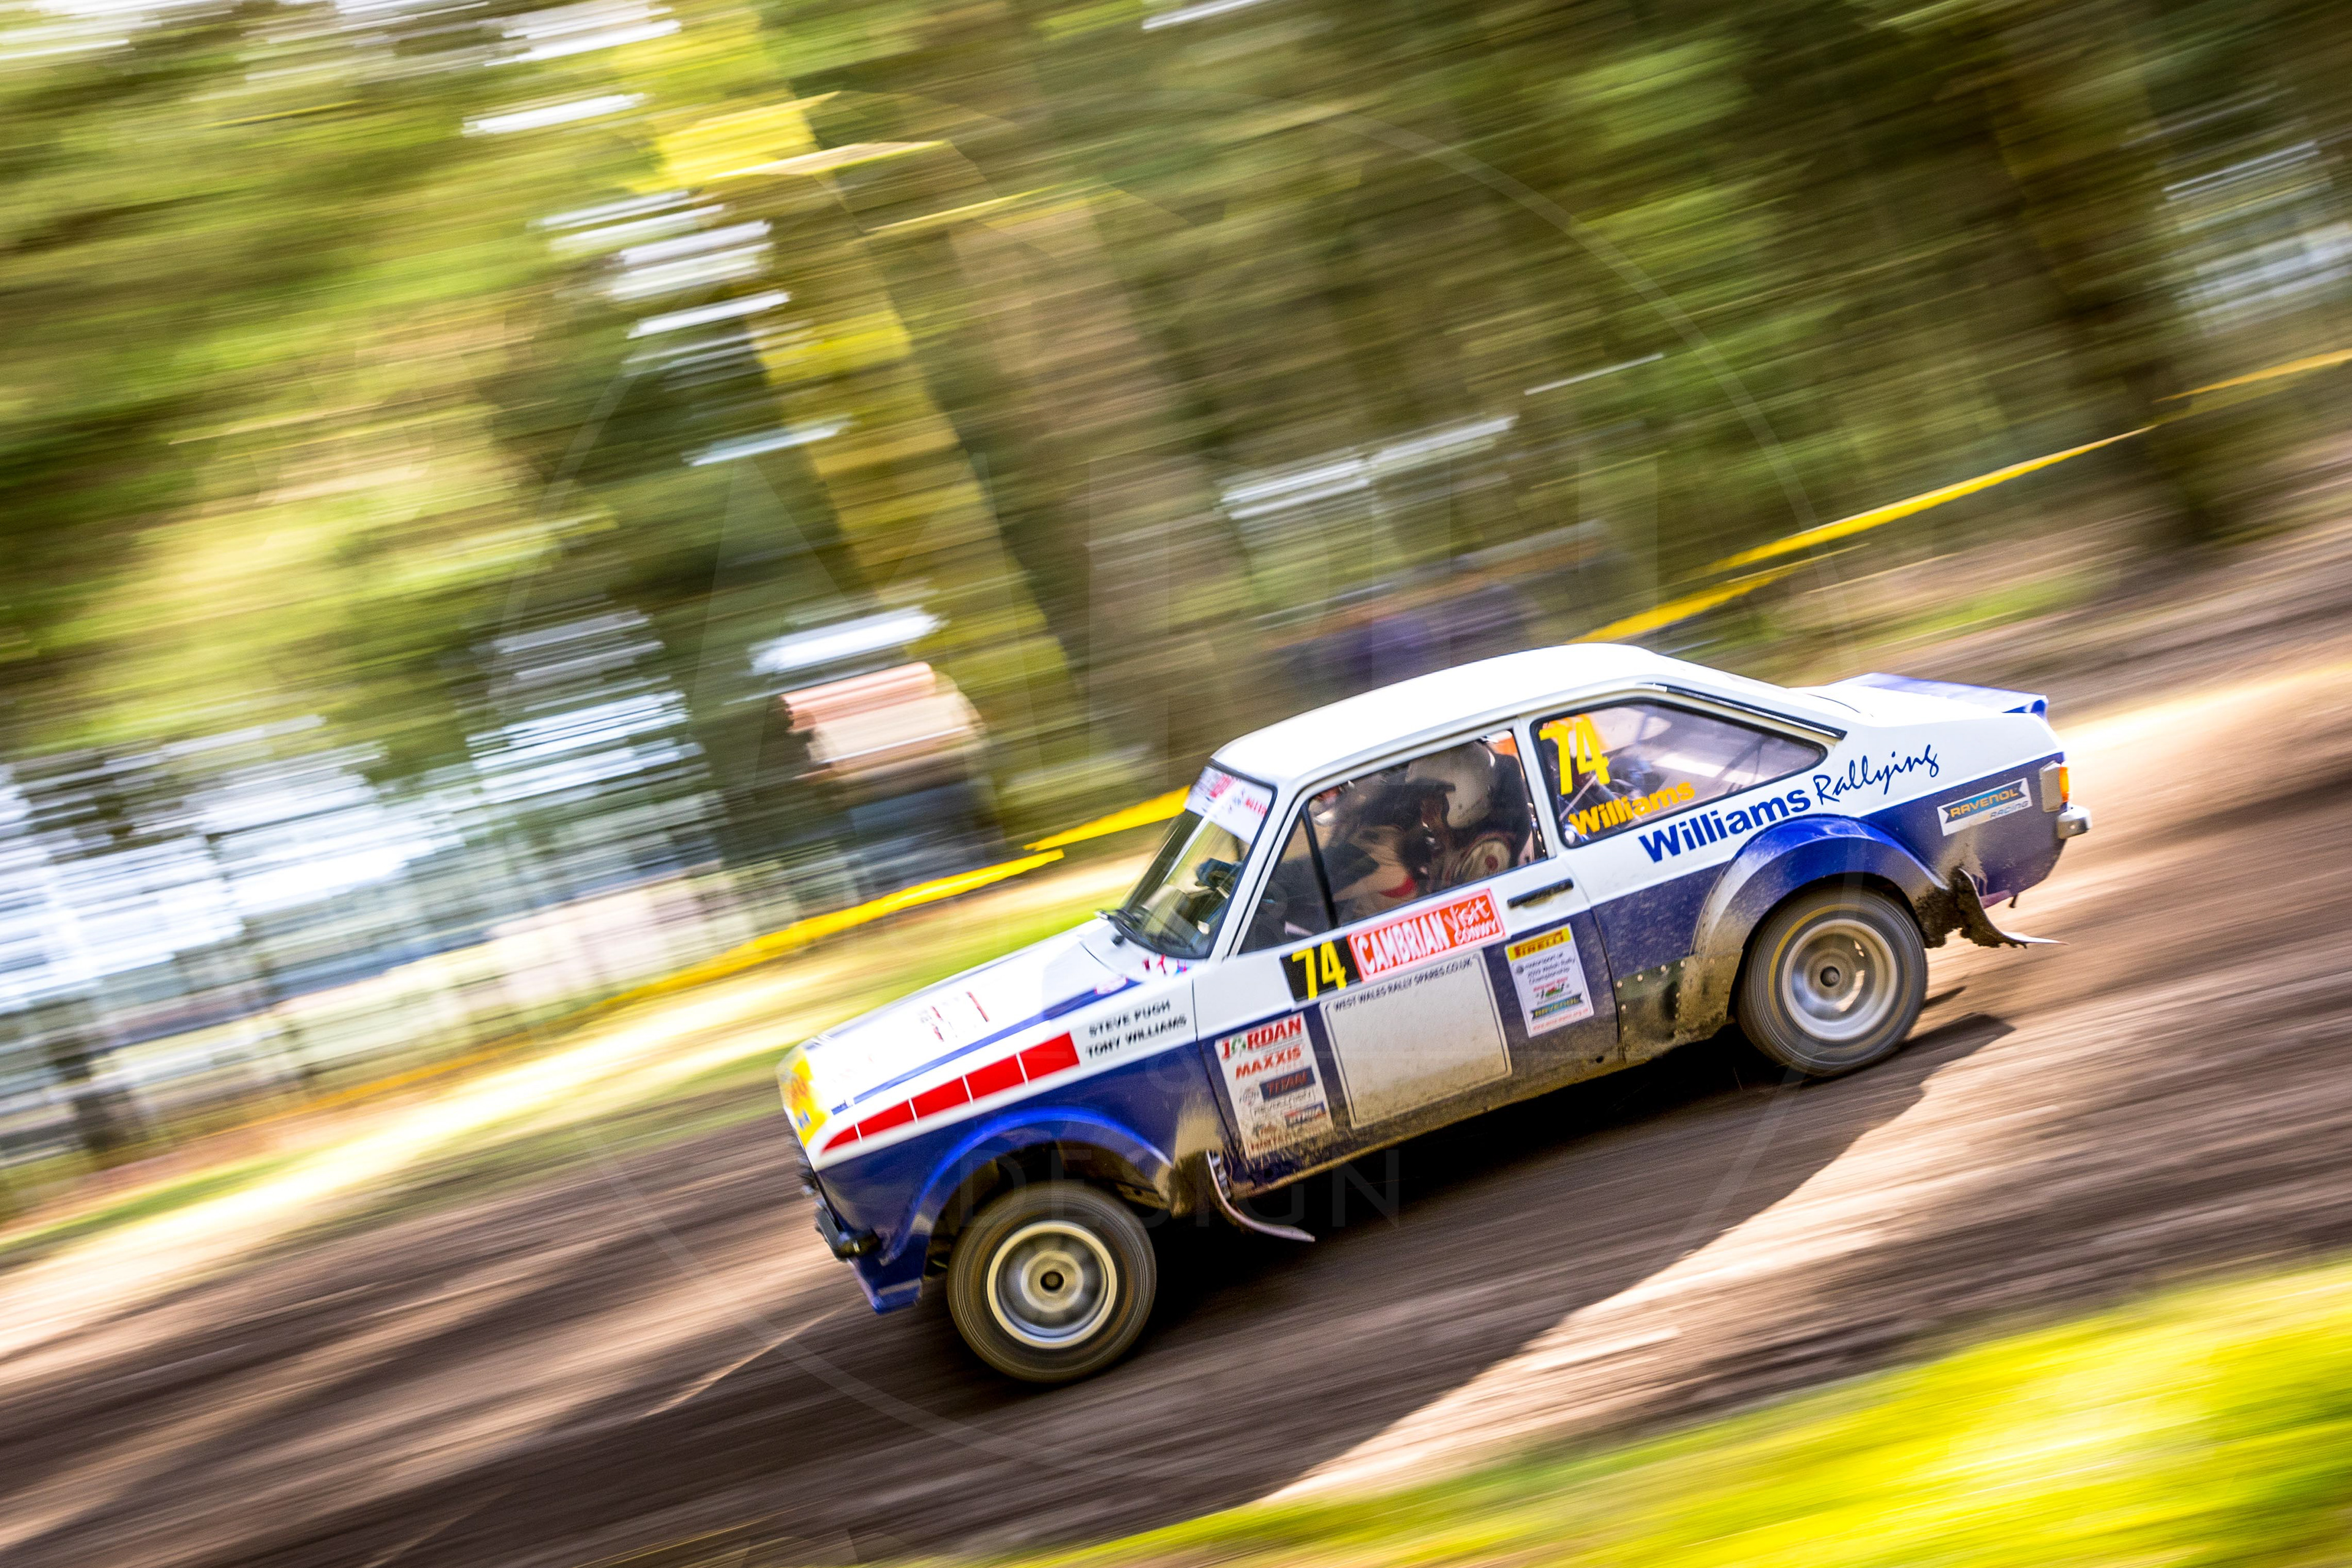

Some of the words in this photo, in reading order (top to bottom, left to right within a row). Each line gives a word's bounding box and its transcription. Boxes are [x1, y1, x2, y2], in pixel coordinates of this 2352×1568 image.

[1539, 718, 1610, 795] 74
[1568, 782, 1695, 835] Williams
[1638, 789, 1811, 863] Williams
[1813, 744, 1940, 805] Rallying
[1950, 788, 2019, 819] RAVENOL
[1988, 801, 2029, 819] RACING
[1444, 898, 1491, 930] Visit
[1357, 910, 1450, 974] CAMBRIAN
[1514, 929, 1564, 958] PIRELLI
[1291, 940, 1348, 1000] 74
[1334, 995, 1357, 1012] WEST
[1358, 987, 1387, 1004] WALES
[1387, 976, 1412, 995] RALLY
[1085, 1035, 1120, 1058] TONY
[1126, 1012, 1187, 1045] WILLIAMS
[1089, 1011, 1131, 1038] STEVE
[1134, 998, 1170, 1022] PUGH
[1221, 1014, 1302, 1061] JORDAN
[1235, 1044, 1302, 1082] MAXXIS
[1267, 1070, 1308, 1096] TITAN
